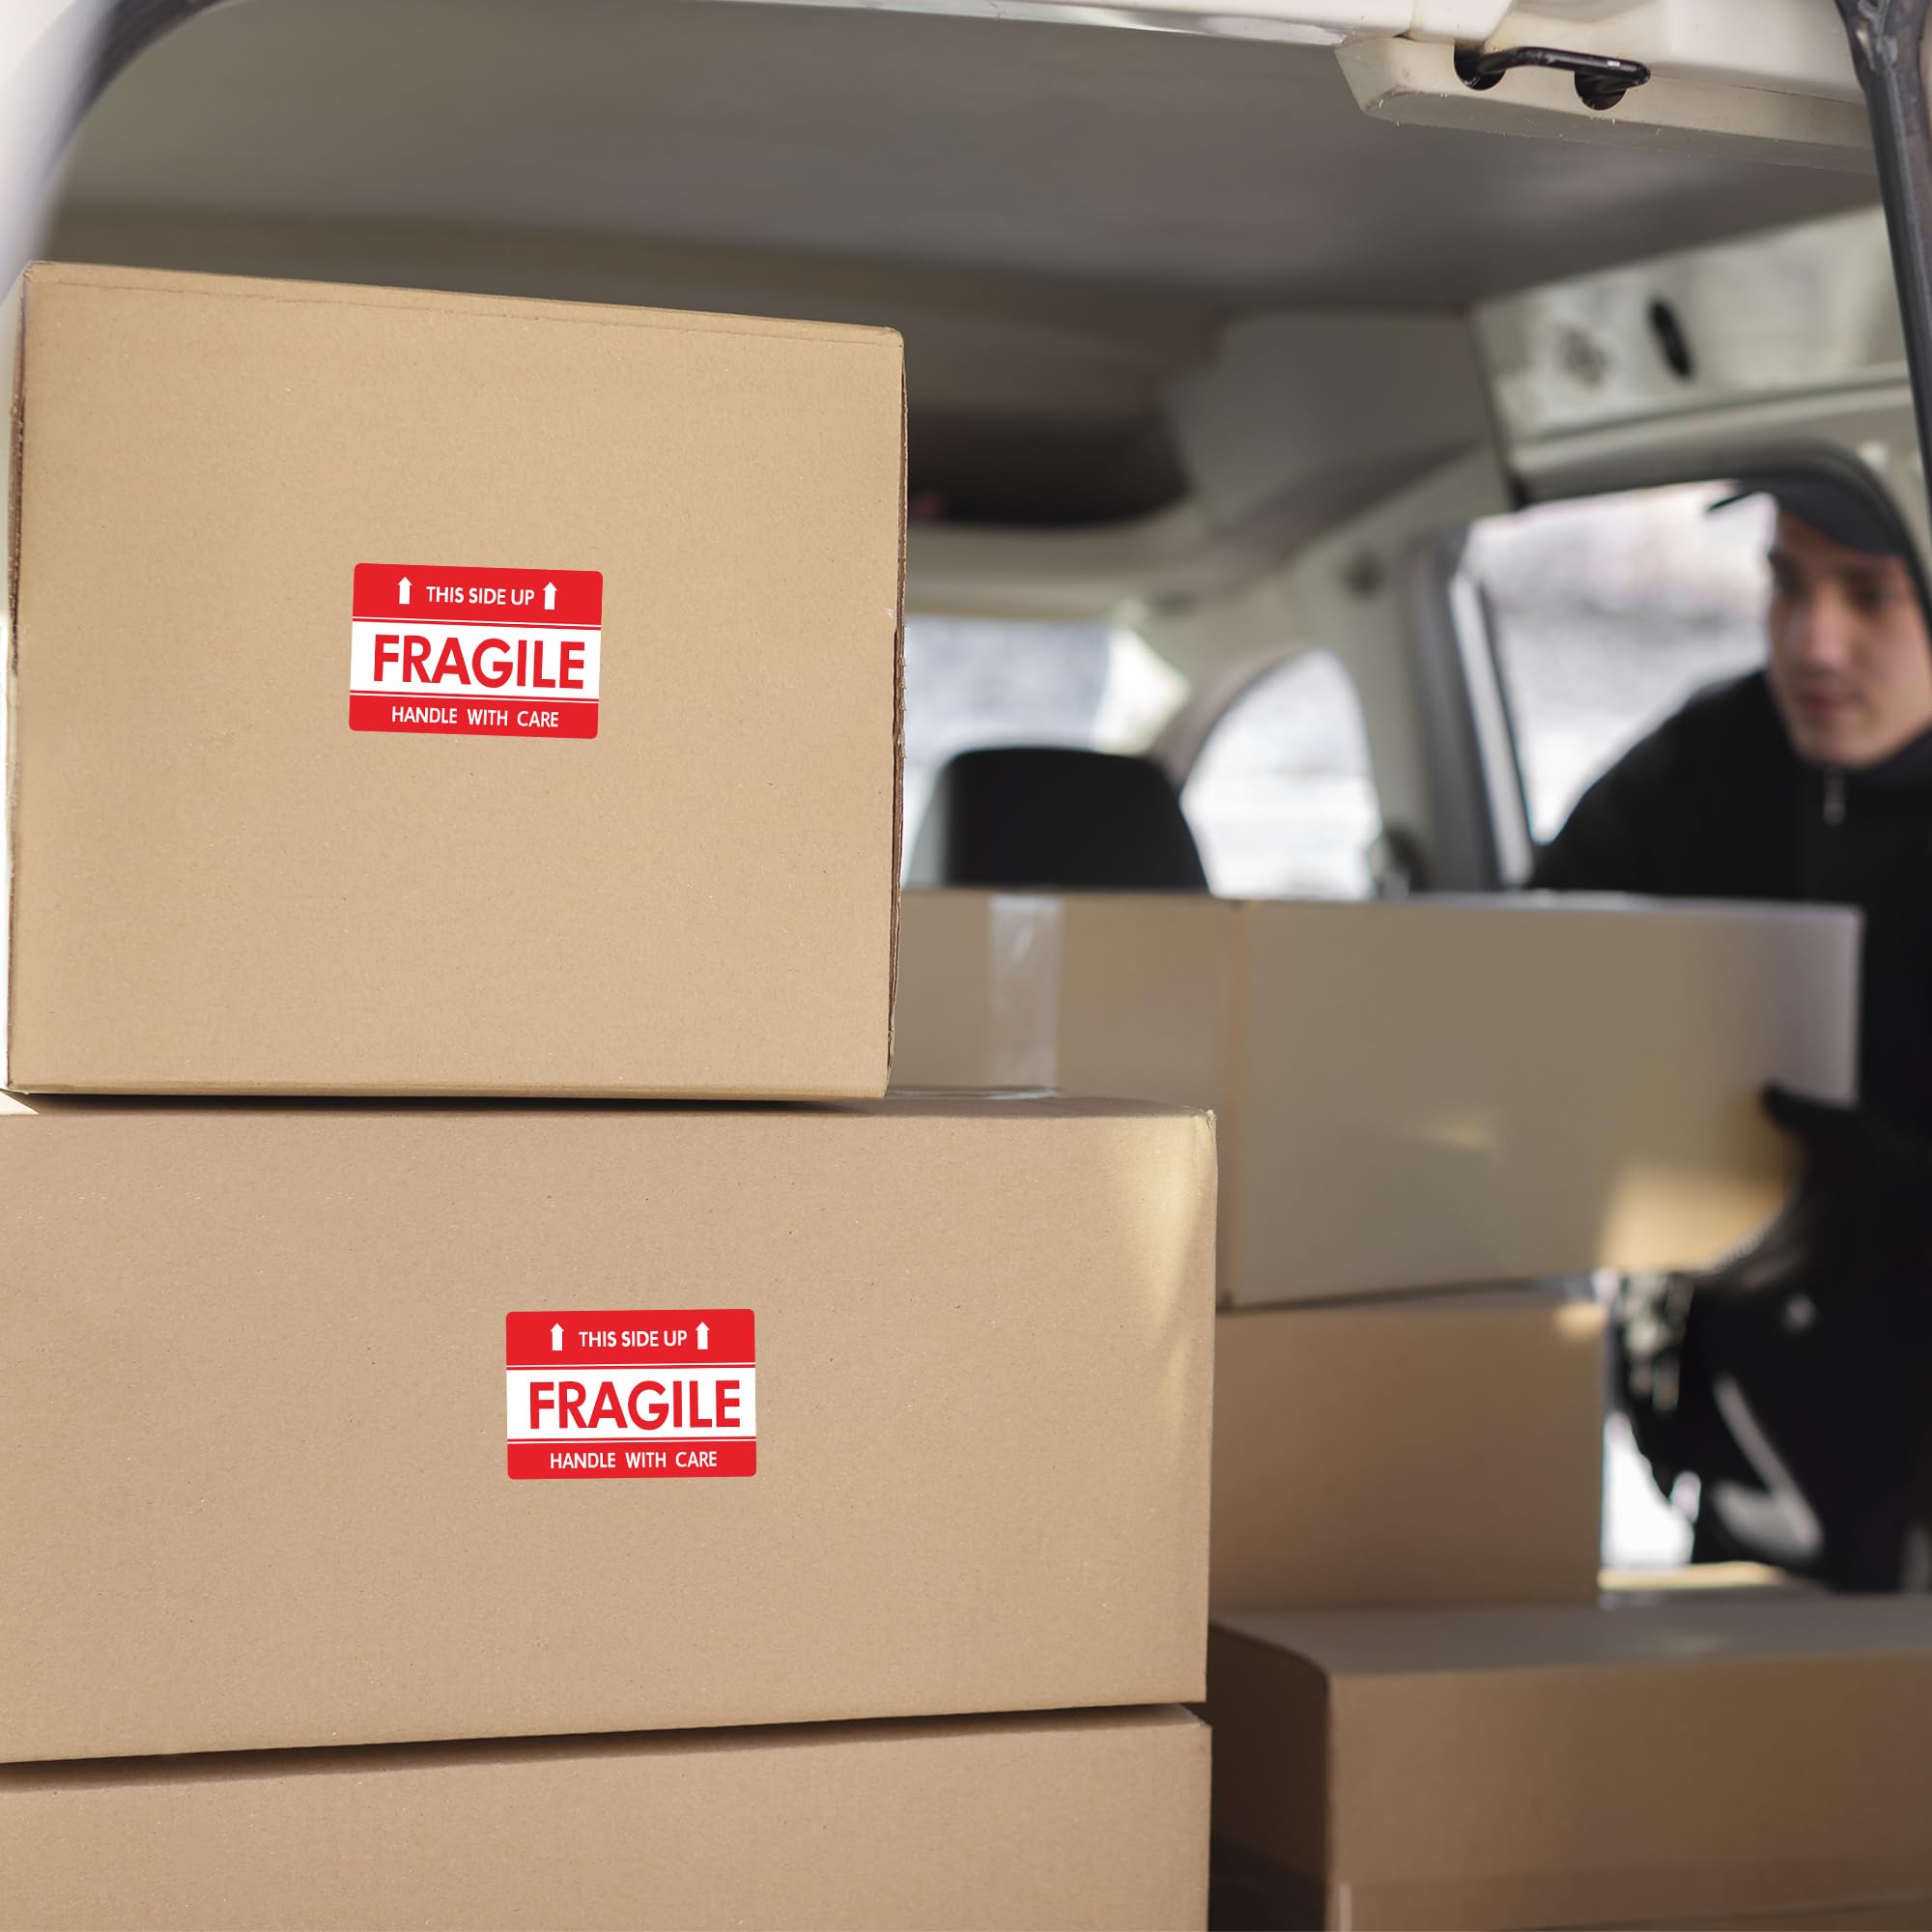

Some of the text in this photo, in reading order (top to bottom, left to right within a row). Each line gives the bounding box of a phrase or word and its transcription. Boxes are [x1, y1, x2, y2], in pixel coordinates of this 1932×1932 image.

[426, 586, 534, 605] THIS SIDE UP
[374, 635, 584, 689] FRAGILE
[392, 706, 558, 727] HANDLE WITH CARE
[579, 1330, 687, 1347] THIS SIDE UP
[530, 1380, 740, 1430] FRAGILE
[551, 1451, 717, 1468] HANDLE WITH CARE
